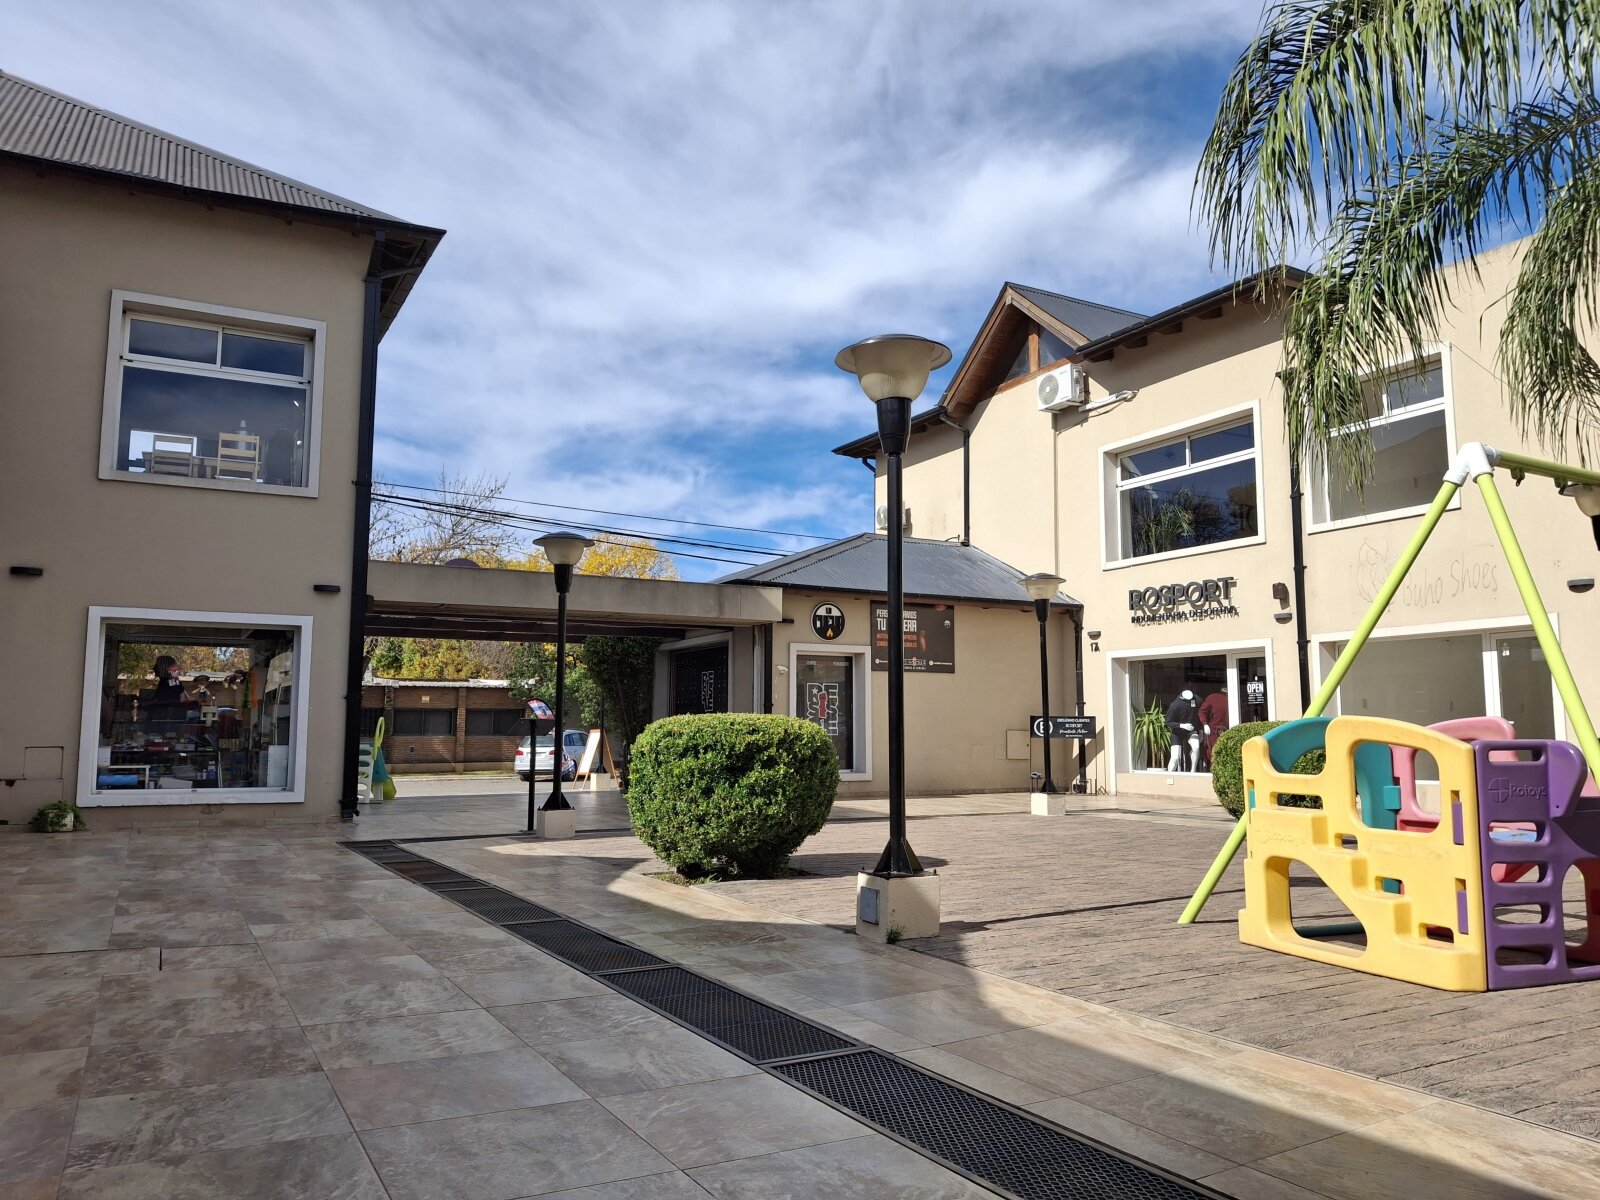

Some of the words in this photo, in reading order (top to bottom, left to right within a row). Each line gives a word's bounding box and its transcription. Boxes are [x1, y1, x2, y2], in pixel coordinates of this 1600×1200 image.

[1450, 552, 1498, 597] Shoes
[1128, 576, 1235, 611] ROSPORT
[1131, 611, 1188, 624] INDUMENTARIA
[1189, 605, 1238, 618] DEPORTIVA
[1247, 683, 1264, 693] OPEN
[1509, 784, 1547, 800] Rotoys
